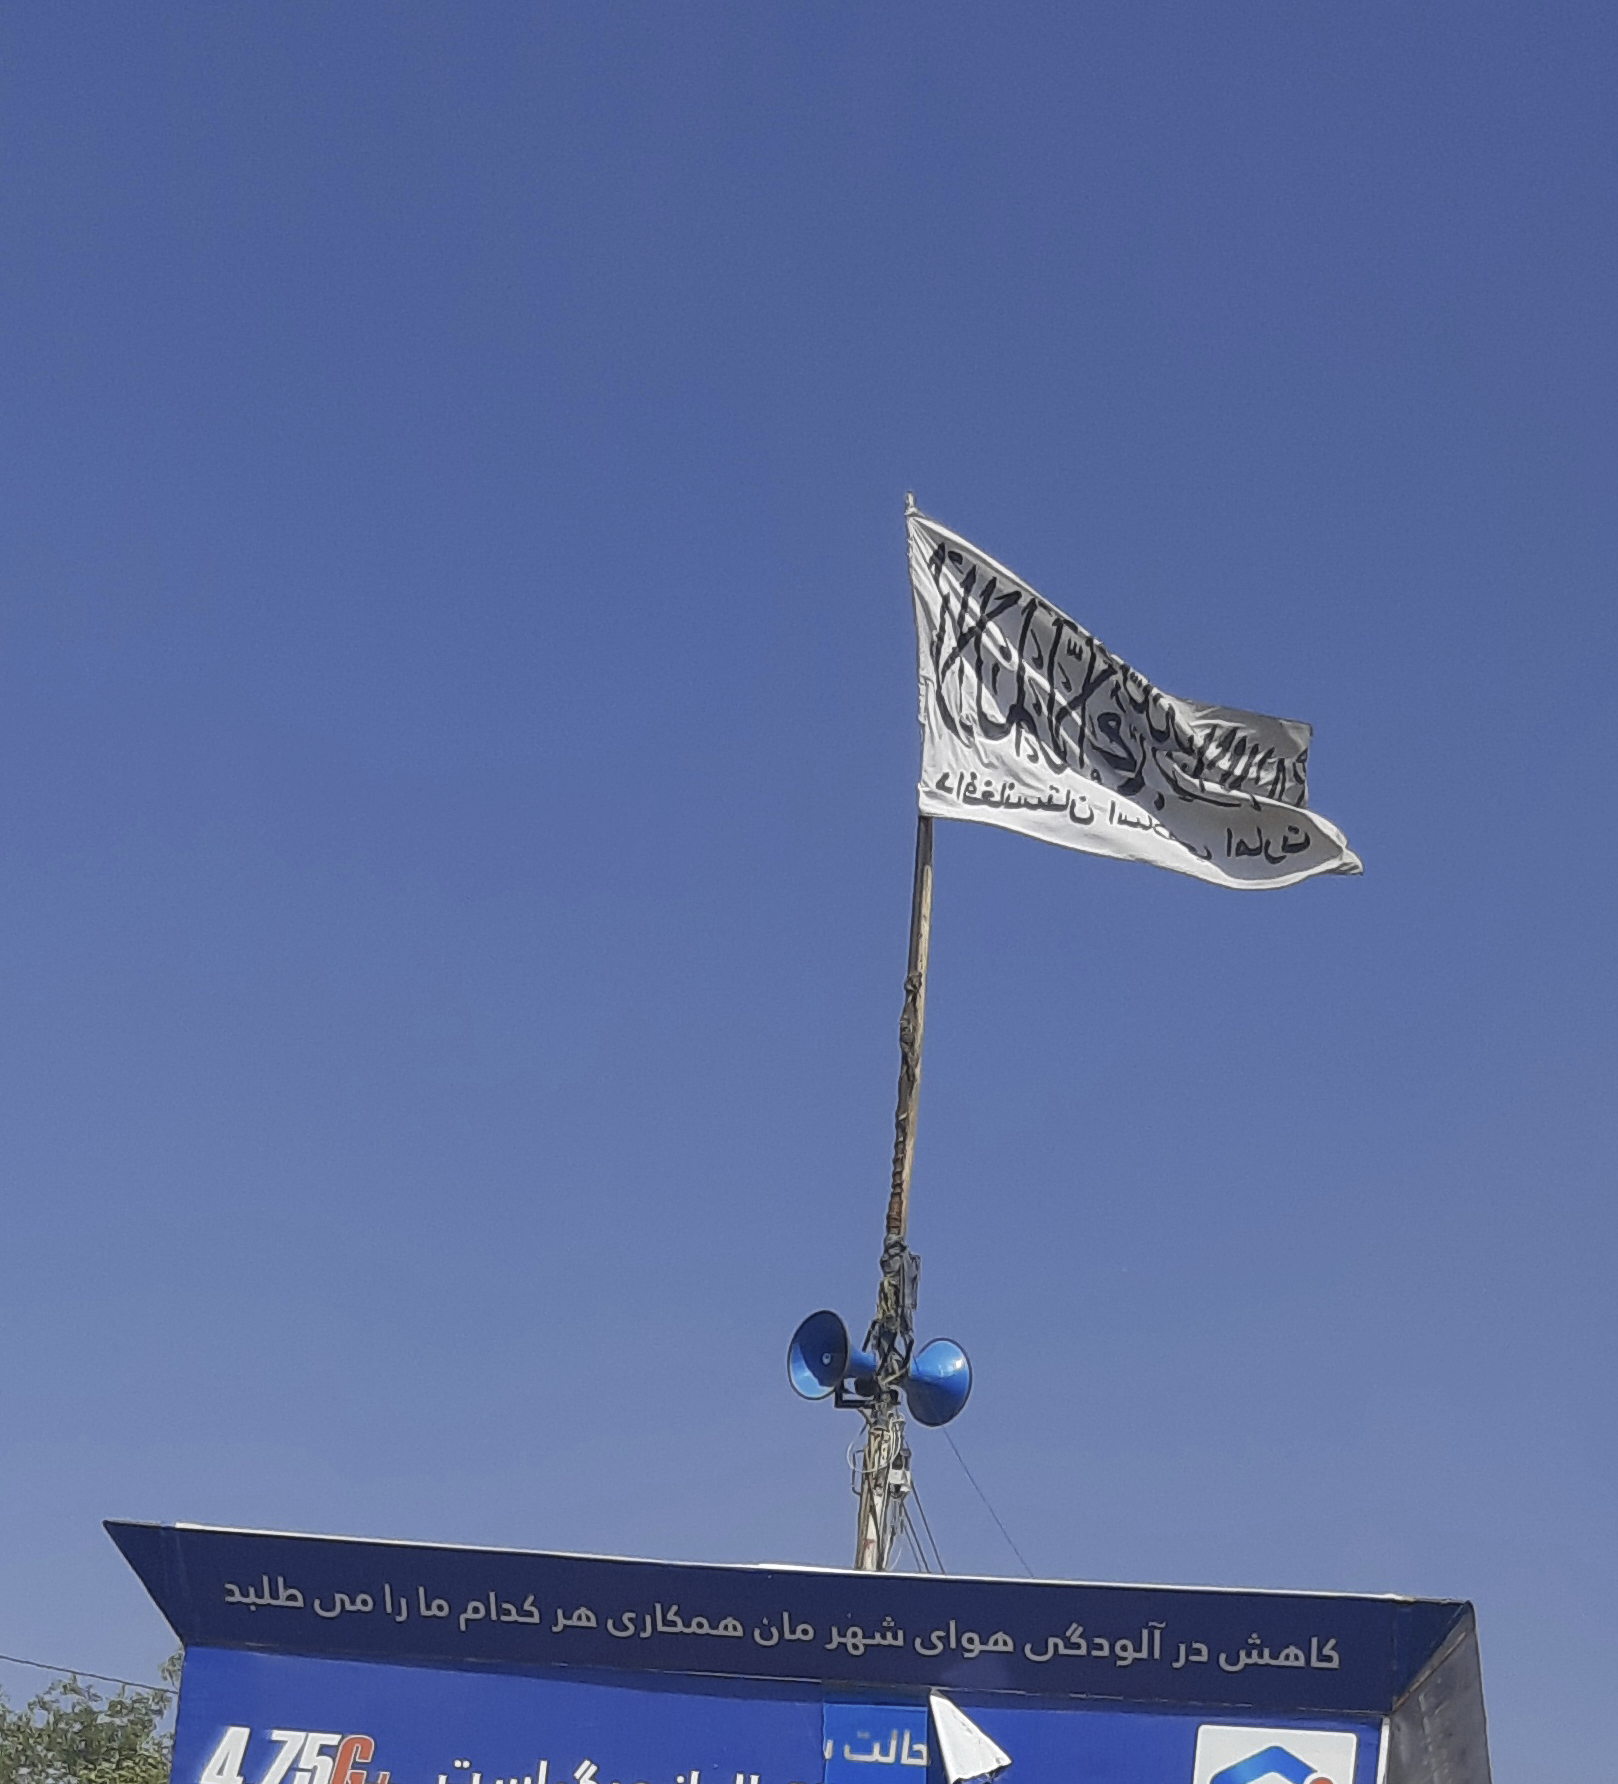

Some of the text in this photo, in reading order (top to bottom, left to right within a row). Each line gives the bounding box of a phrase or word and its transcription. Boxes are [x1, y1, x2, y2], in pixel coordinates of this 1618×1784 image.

[223, 1574, 1342, 1672] کاهش در آلودگی هوای شهر مان همکاری هر کدام ما را می طلبد
